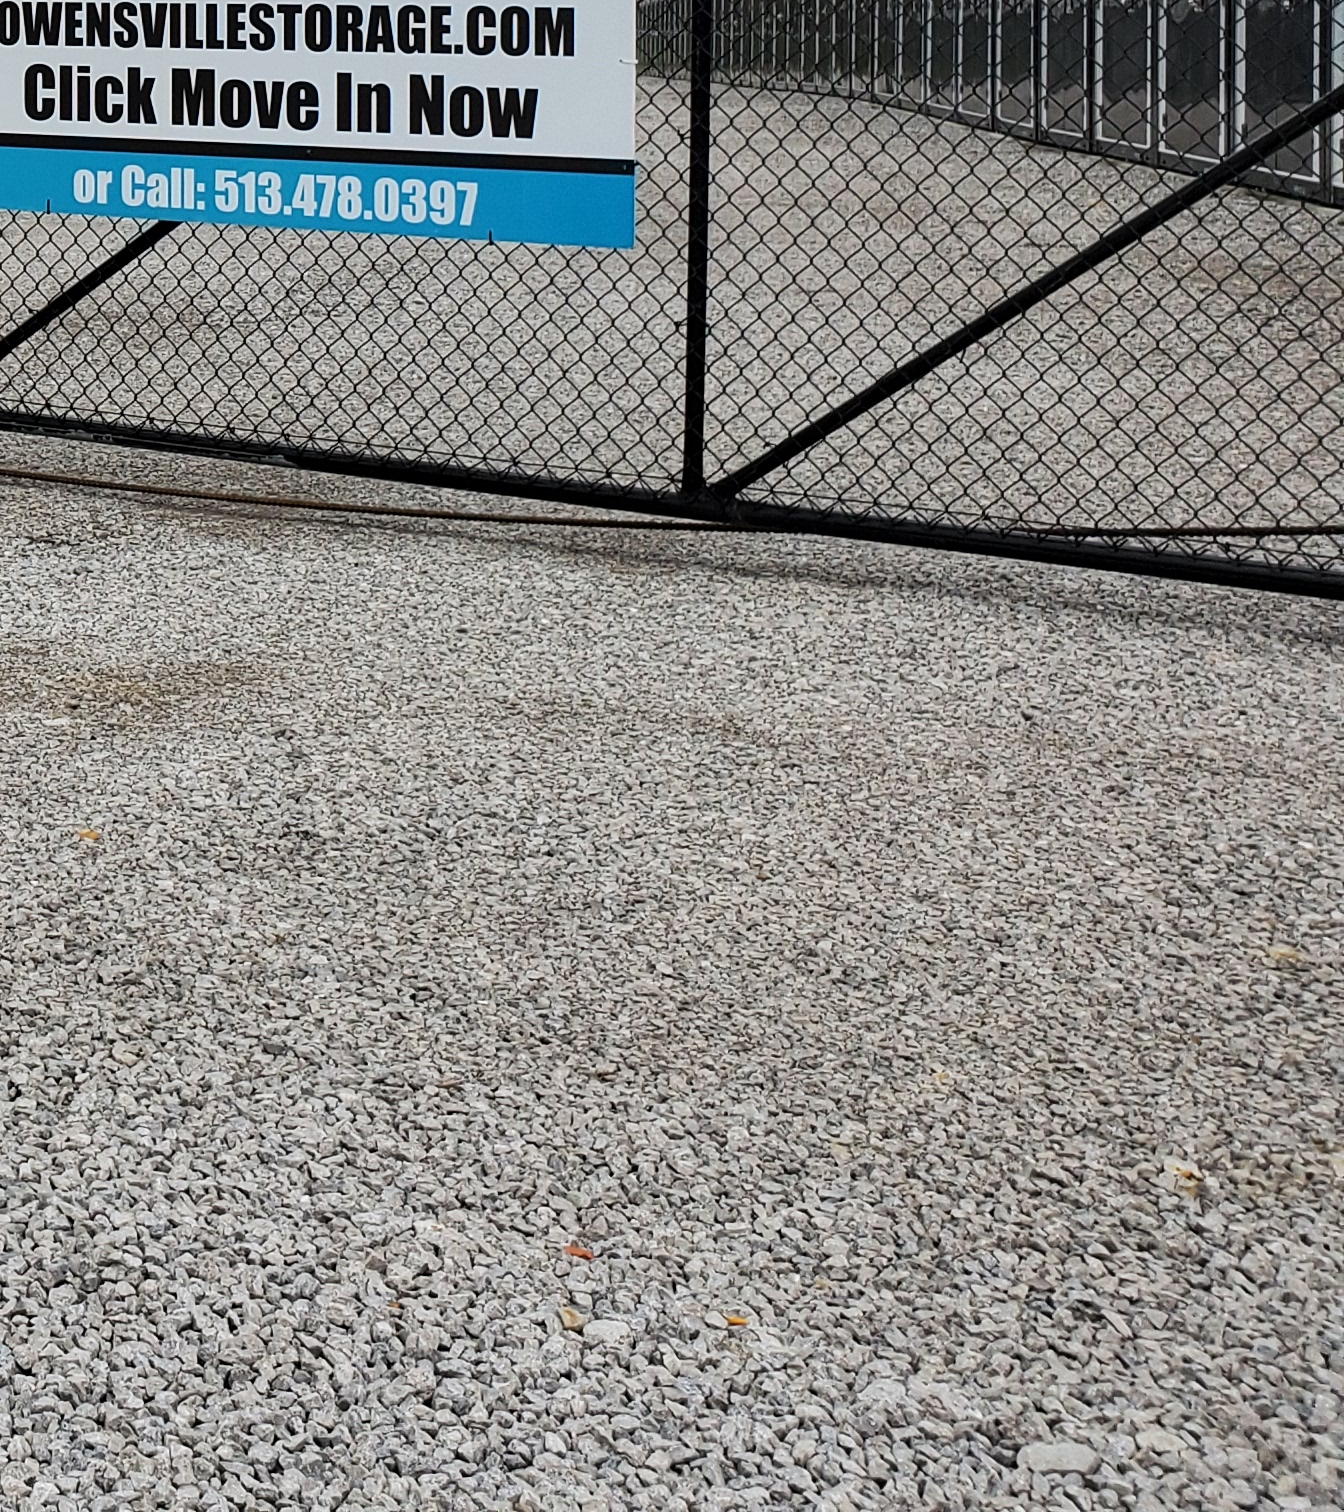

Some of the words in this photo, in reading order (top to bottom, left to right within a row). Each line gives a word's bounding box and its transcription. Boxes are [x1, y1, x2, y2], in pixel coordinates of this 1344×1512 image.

[24, 63, 157, 125] Click
[171, 68, 321, 130] Move
[337, 71, 391, 134] In
[408, 75, 538, 139] Now
[74, 170, 115, 204] or
[121, 165, 205, 210] Call:
[215, 169, 478, 226] 513.478.0397
